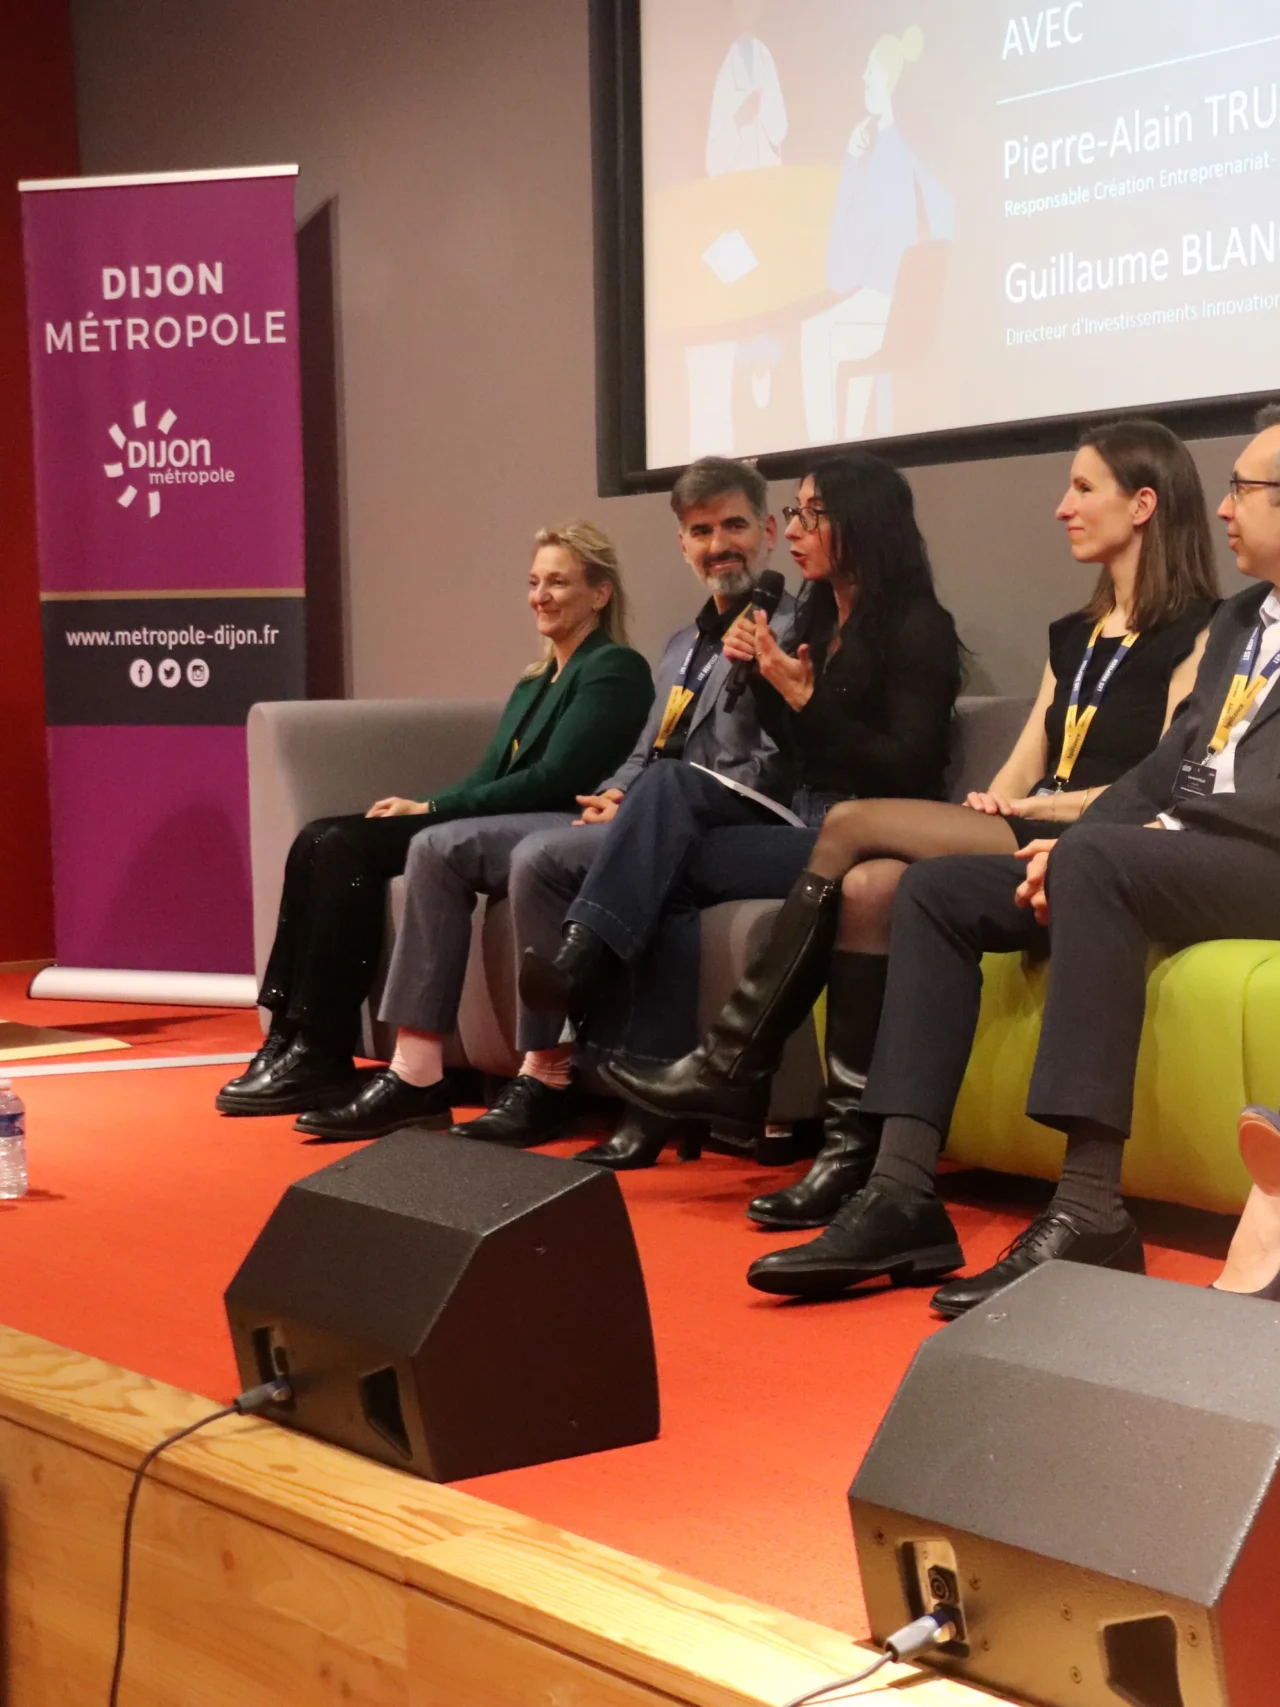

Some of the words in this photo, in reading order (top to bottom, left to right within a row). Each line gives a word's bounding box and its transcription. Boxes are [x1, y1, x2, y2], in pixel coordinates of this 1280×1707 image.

[1001, 1, 1084, 60] AVEC
[1003, 104, 1193, 180] Pierre-Alain
[1005, 185, 1090, 218] Responsable
[1093, 172, 1155, 201] Création
[102, 261, 224, 301] DIJON
[1005, 245, 1169, 303] Guillaume
[45, 310, 287, 354] MÉTROPOLE
[1006, 319, 1068, 347] Directeur
[1071, 302, 1198, 338] d'Investissements
[149, 467, 236, 486] métropole
[65, 624, 280, 651] www.metropole-dijon.fr
